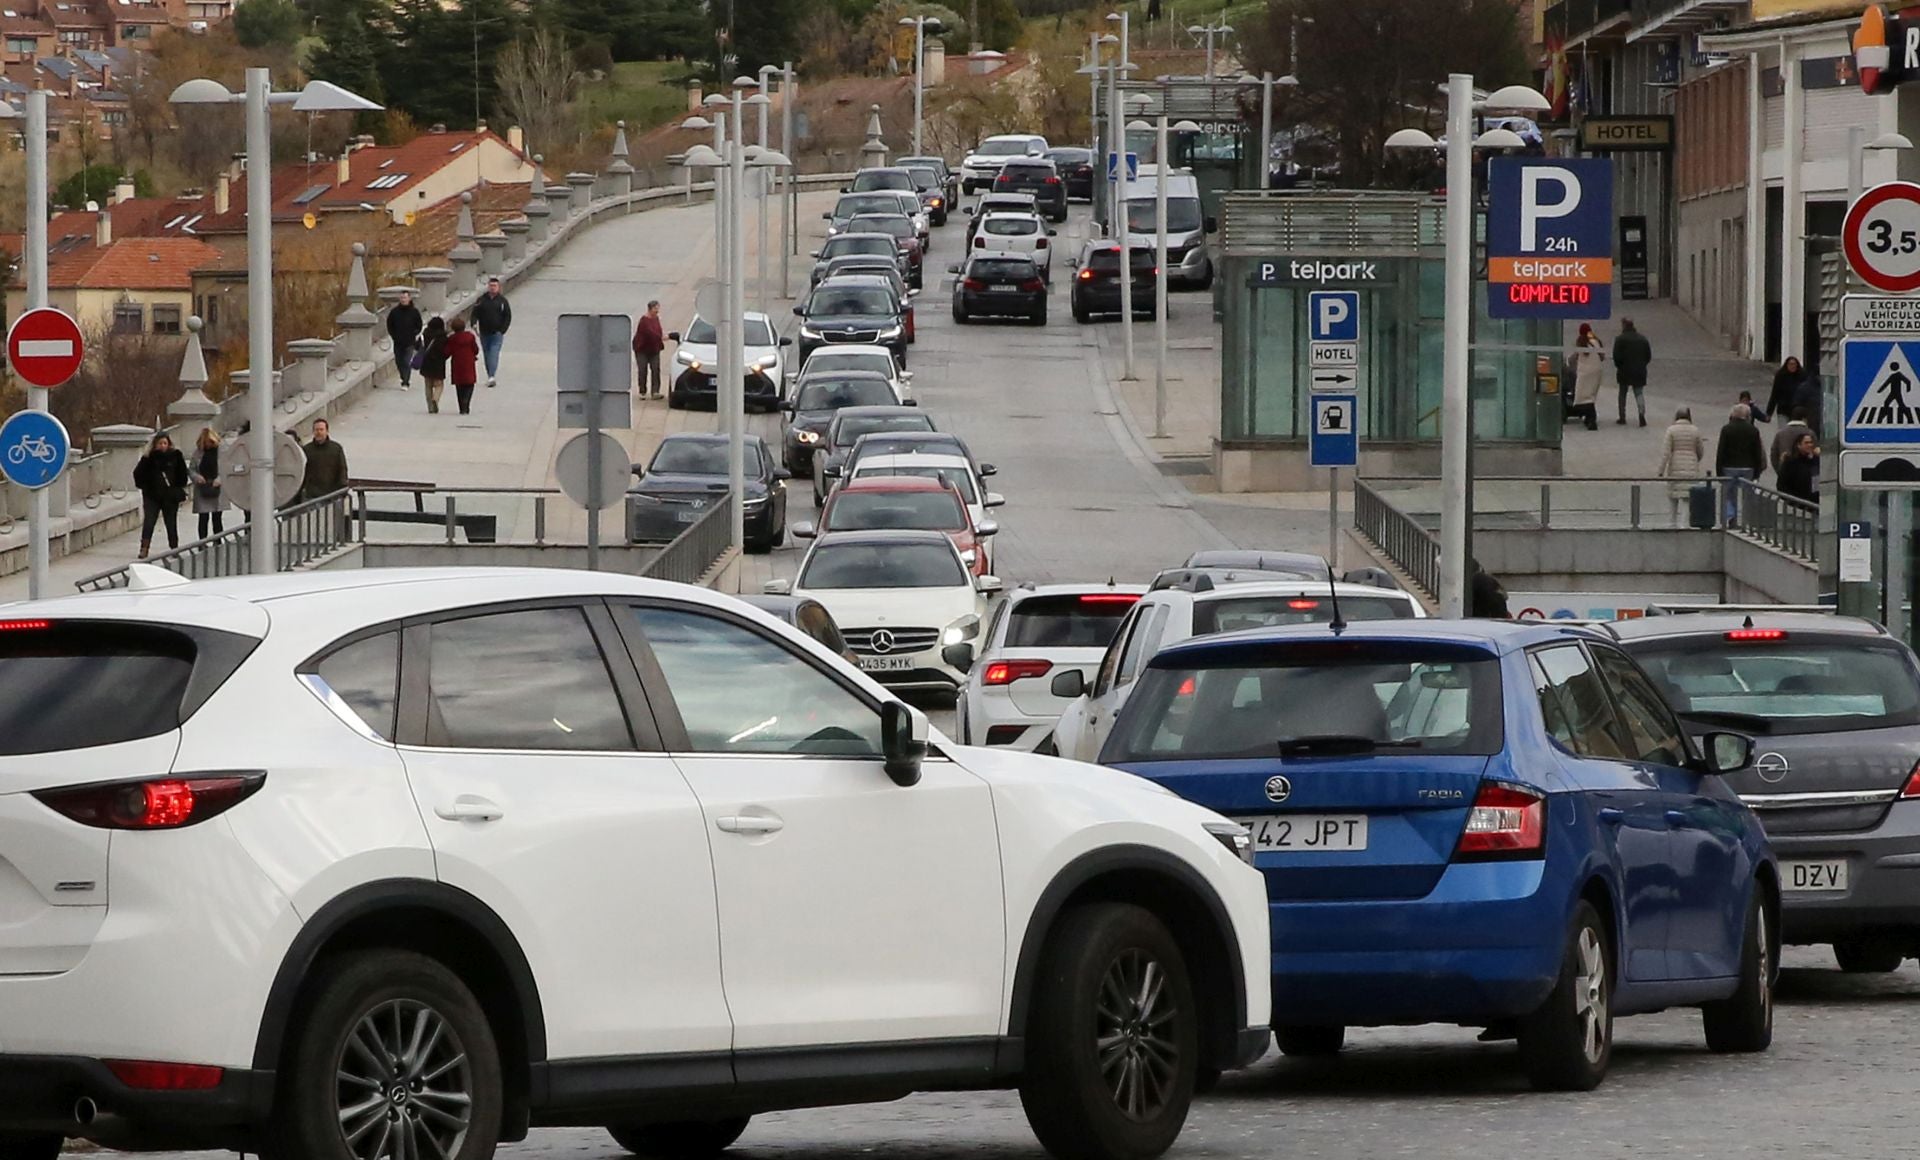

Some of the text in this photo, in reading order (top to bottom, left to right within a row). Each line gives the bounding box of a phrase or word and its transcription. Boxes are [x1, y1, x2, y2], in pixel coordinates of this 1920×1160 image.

[1597, 125, 1656, 139] HOTEL
[1520, 166, 1582, 252] P
[1545, 237, 1578, 252] 24h
[1867, 219, 1920, 256] 3,5
[1262, 260, 1377, 284] P telpark
[1513, 261, 1587, 281] telpark
[1510, 284, 1590, 304] COMPLETO
[1319, 298, 1349, 335] P
[1315, 348, 1353, 360] HOTEL
[1849, 523, 1861, 537] P
[1418, 789, 1463, 799] FABIA
[1304, 820, 1359, 847] JPT
[1793, 864, 1839, 887] DZV
